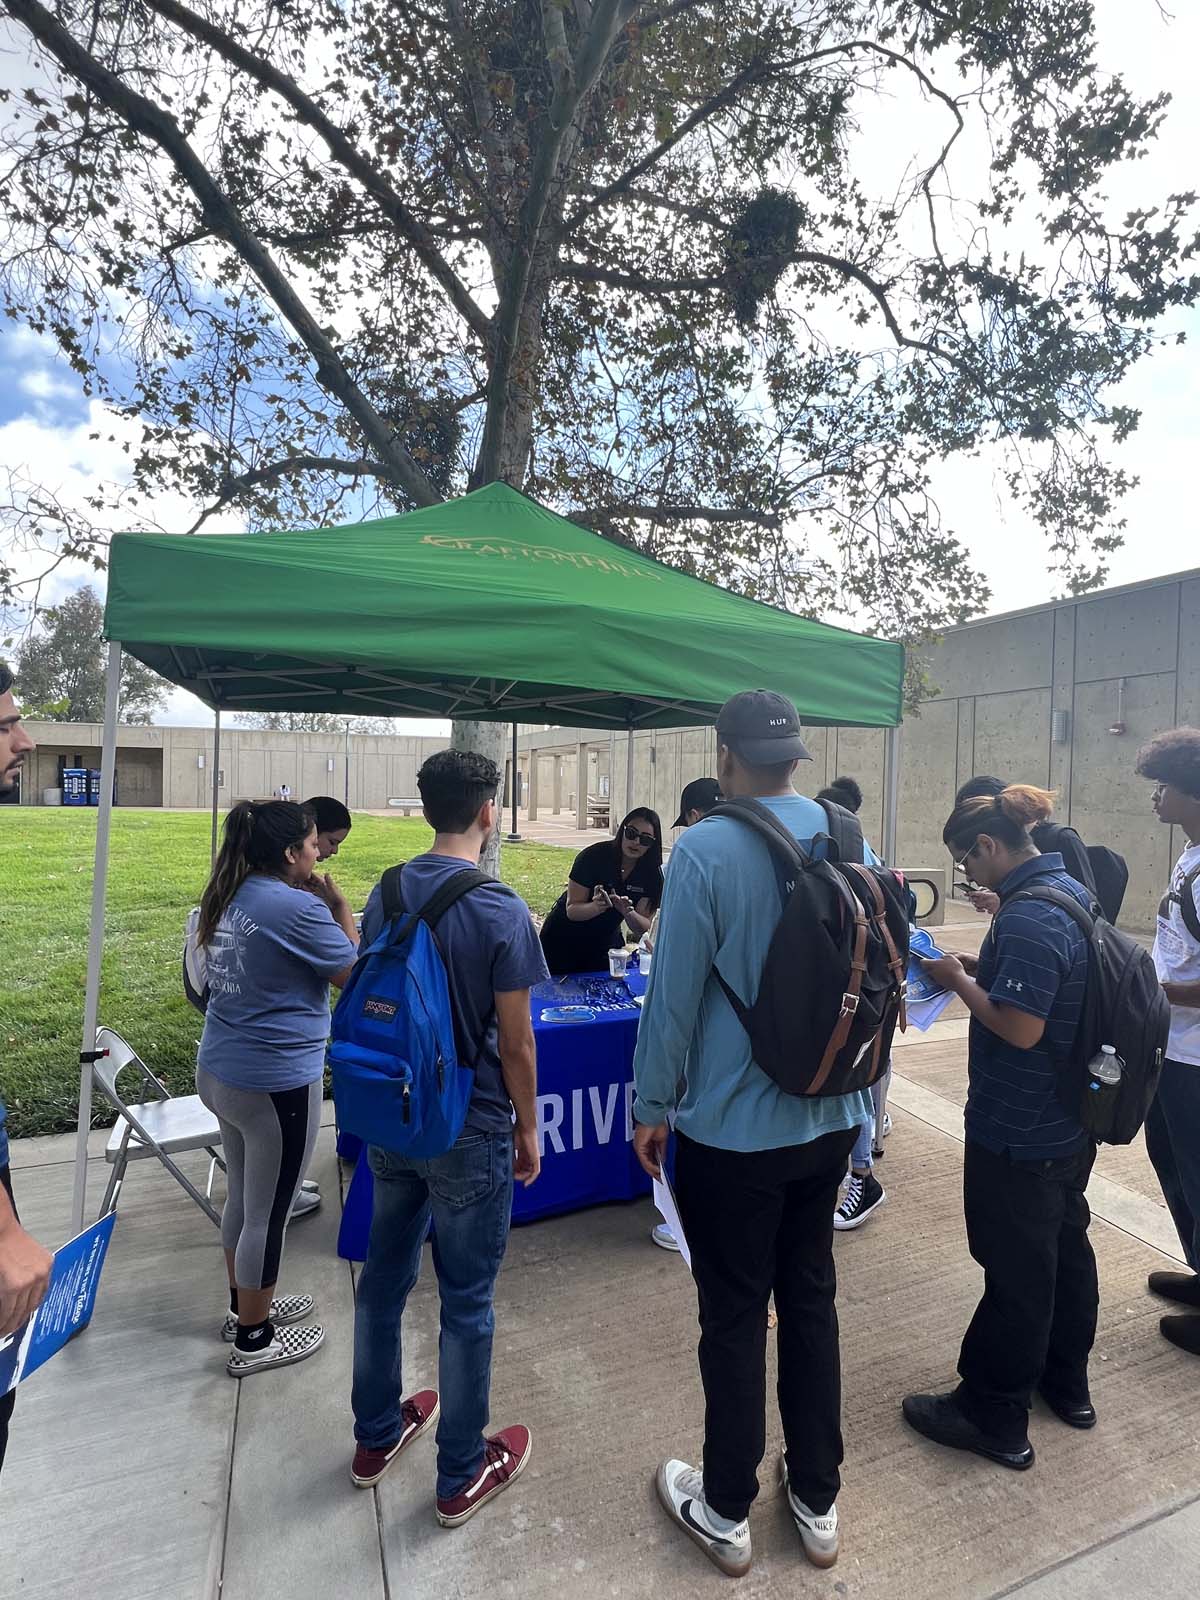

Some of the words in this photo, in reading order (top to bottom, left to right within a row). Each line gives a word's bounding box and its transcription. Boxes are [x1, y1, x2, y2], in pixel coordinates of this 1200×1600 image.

[769, 718, 787, 726] HUF
[814, 1520, 833, 1532] NIKE
[735, 1527, 749, 1539] NIK
